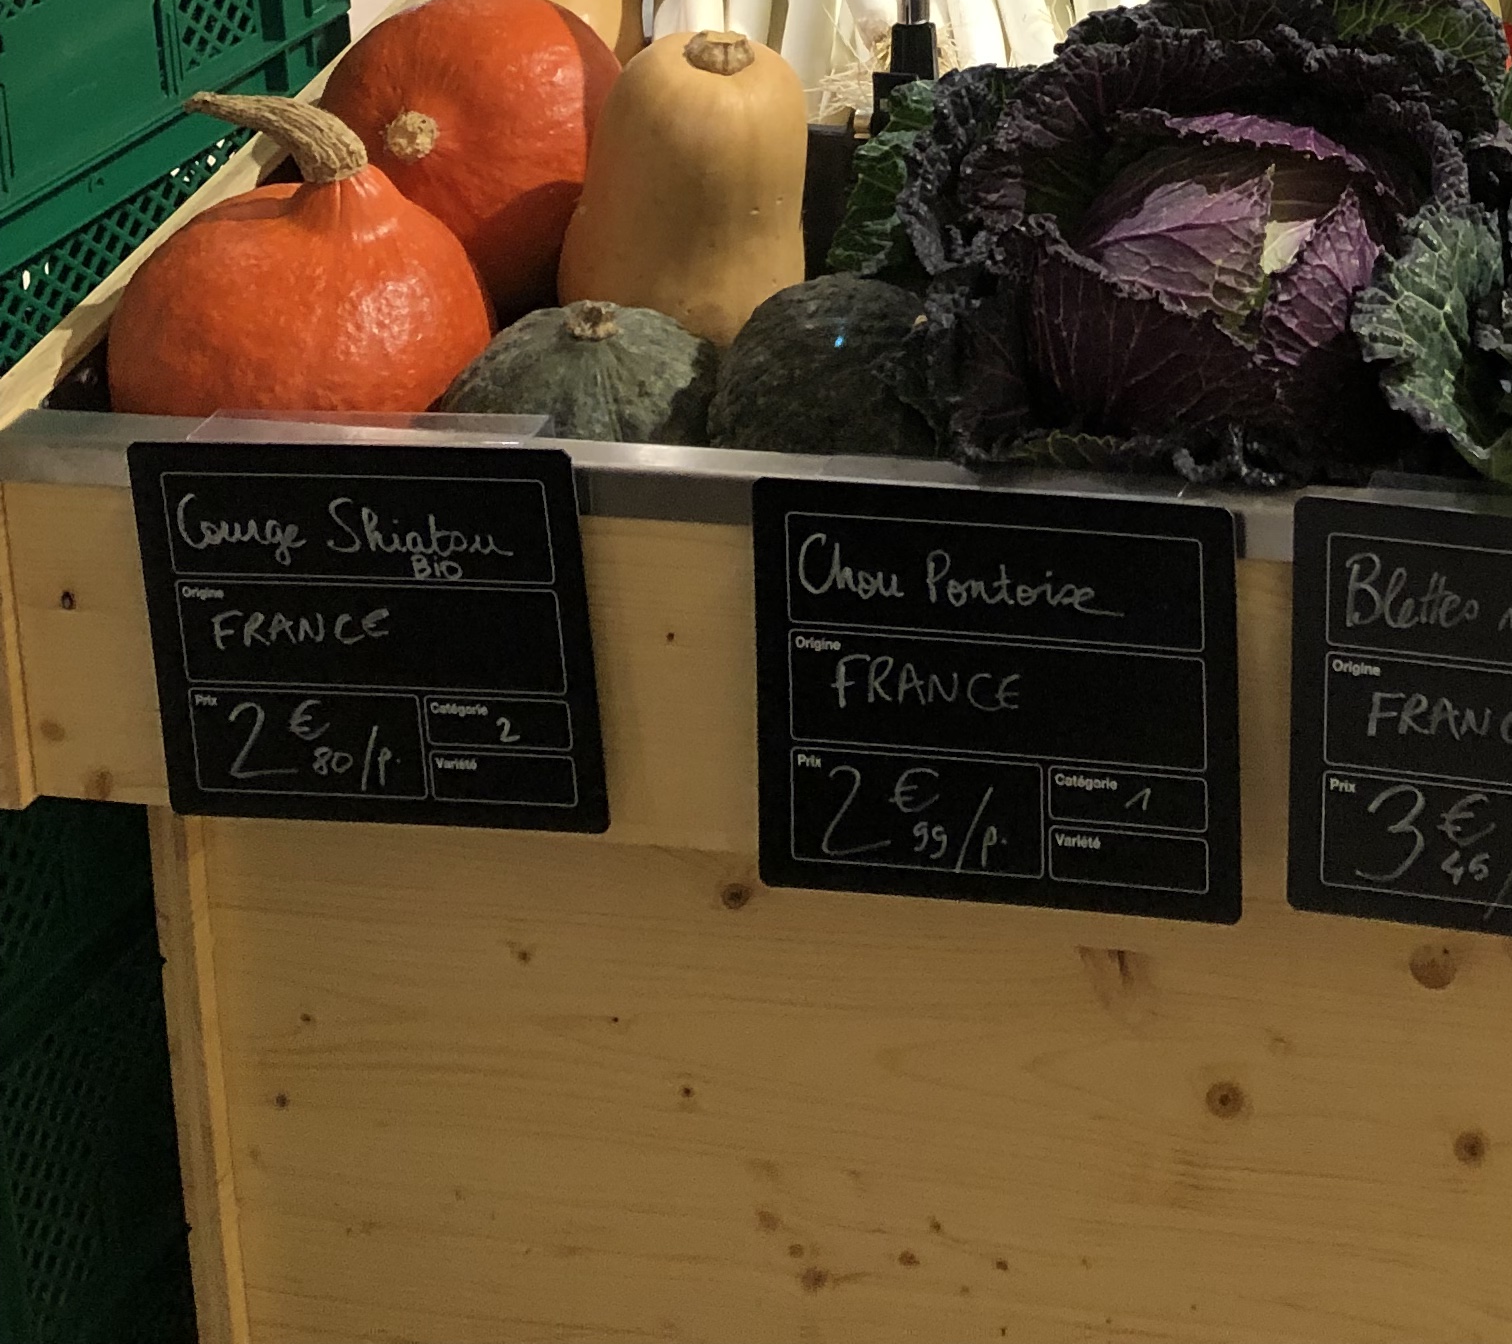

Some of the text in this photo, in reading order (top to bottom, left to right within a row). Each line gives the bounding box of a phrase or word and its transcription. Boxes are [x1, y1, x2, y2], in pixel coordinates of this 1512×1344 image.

[176, 493, 307, 566] Courge
[799, 533, 1124, 617] Chou Pontoise
[182, 585, 224, 600] Origine
[1345, 551, 1479, 629] Blettes
[211, 608, 391, 650] FRANCE
[795, 635, 841, 652] Origine
[1332, 659, 1381, 677] Origine
[831, 655, 1021, 711] FRANCE
[194, 694, 218, 708] Prix
[430, 701, 521, 743] Catégorie 2
[435, 758, 478, 772] Variété
[797, 753, 822, 768] Prix
[1054, 772, 1152, 812] Catégorie 1
[1329, 779, 1357, 794] Prix
[1056, 833, 1101, 850] Variété
